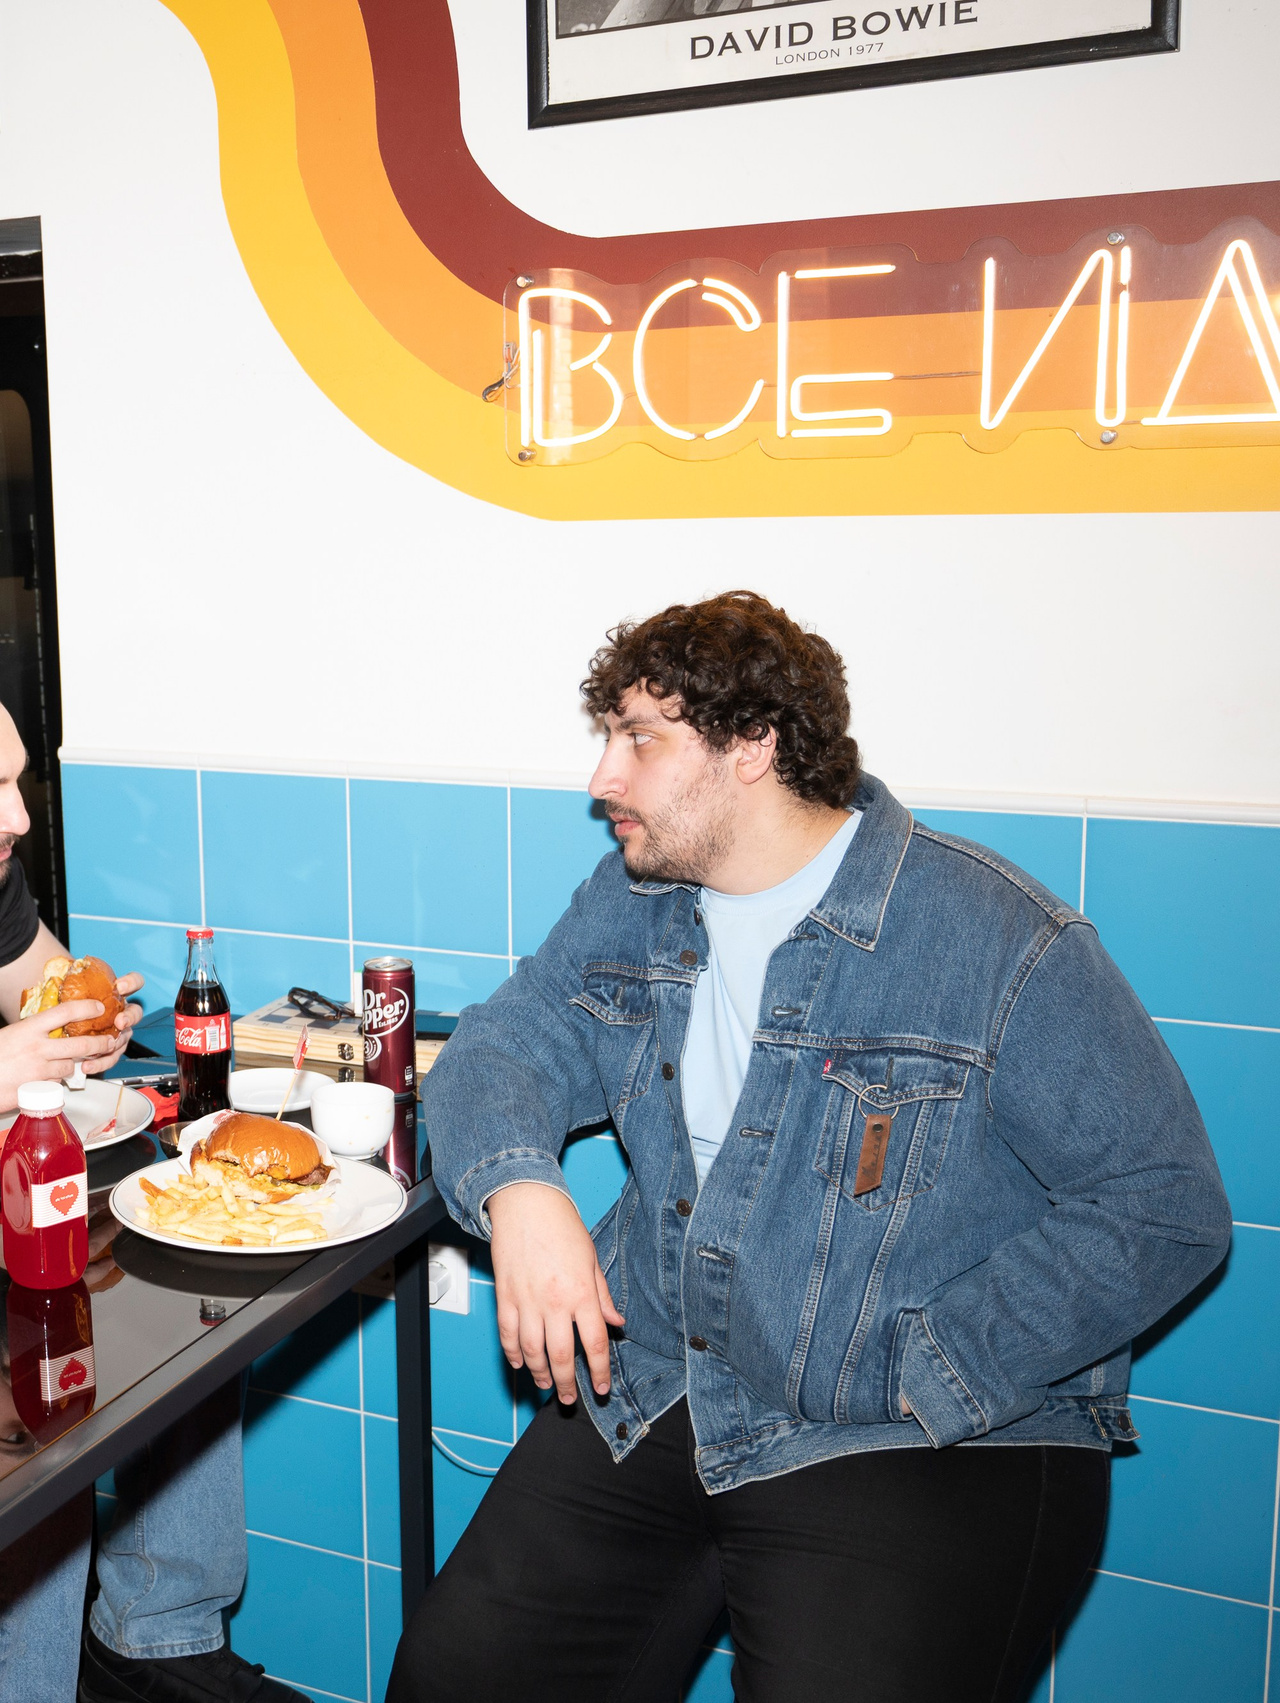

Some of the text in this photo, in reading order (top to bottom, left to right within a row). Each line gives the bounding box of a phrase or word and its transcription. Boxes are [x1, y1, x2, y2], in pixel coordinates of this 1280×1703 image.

[689, 0, 980, 61] DAVID BOWIE
[774, 42, 885, 65] LONDON 1977
[517, 262, 897, 448] ВСЕ
[363, 988, 387, 1011] Dr
